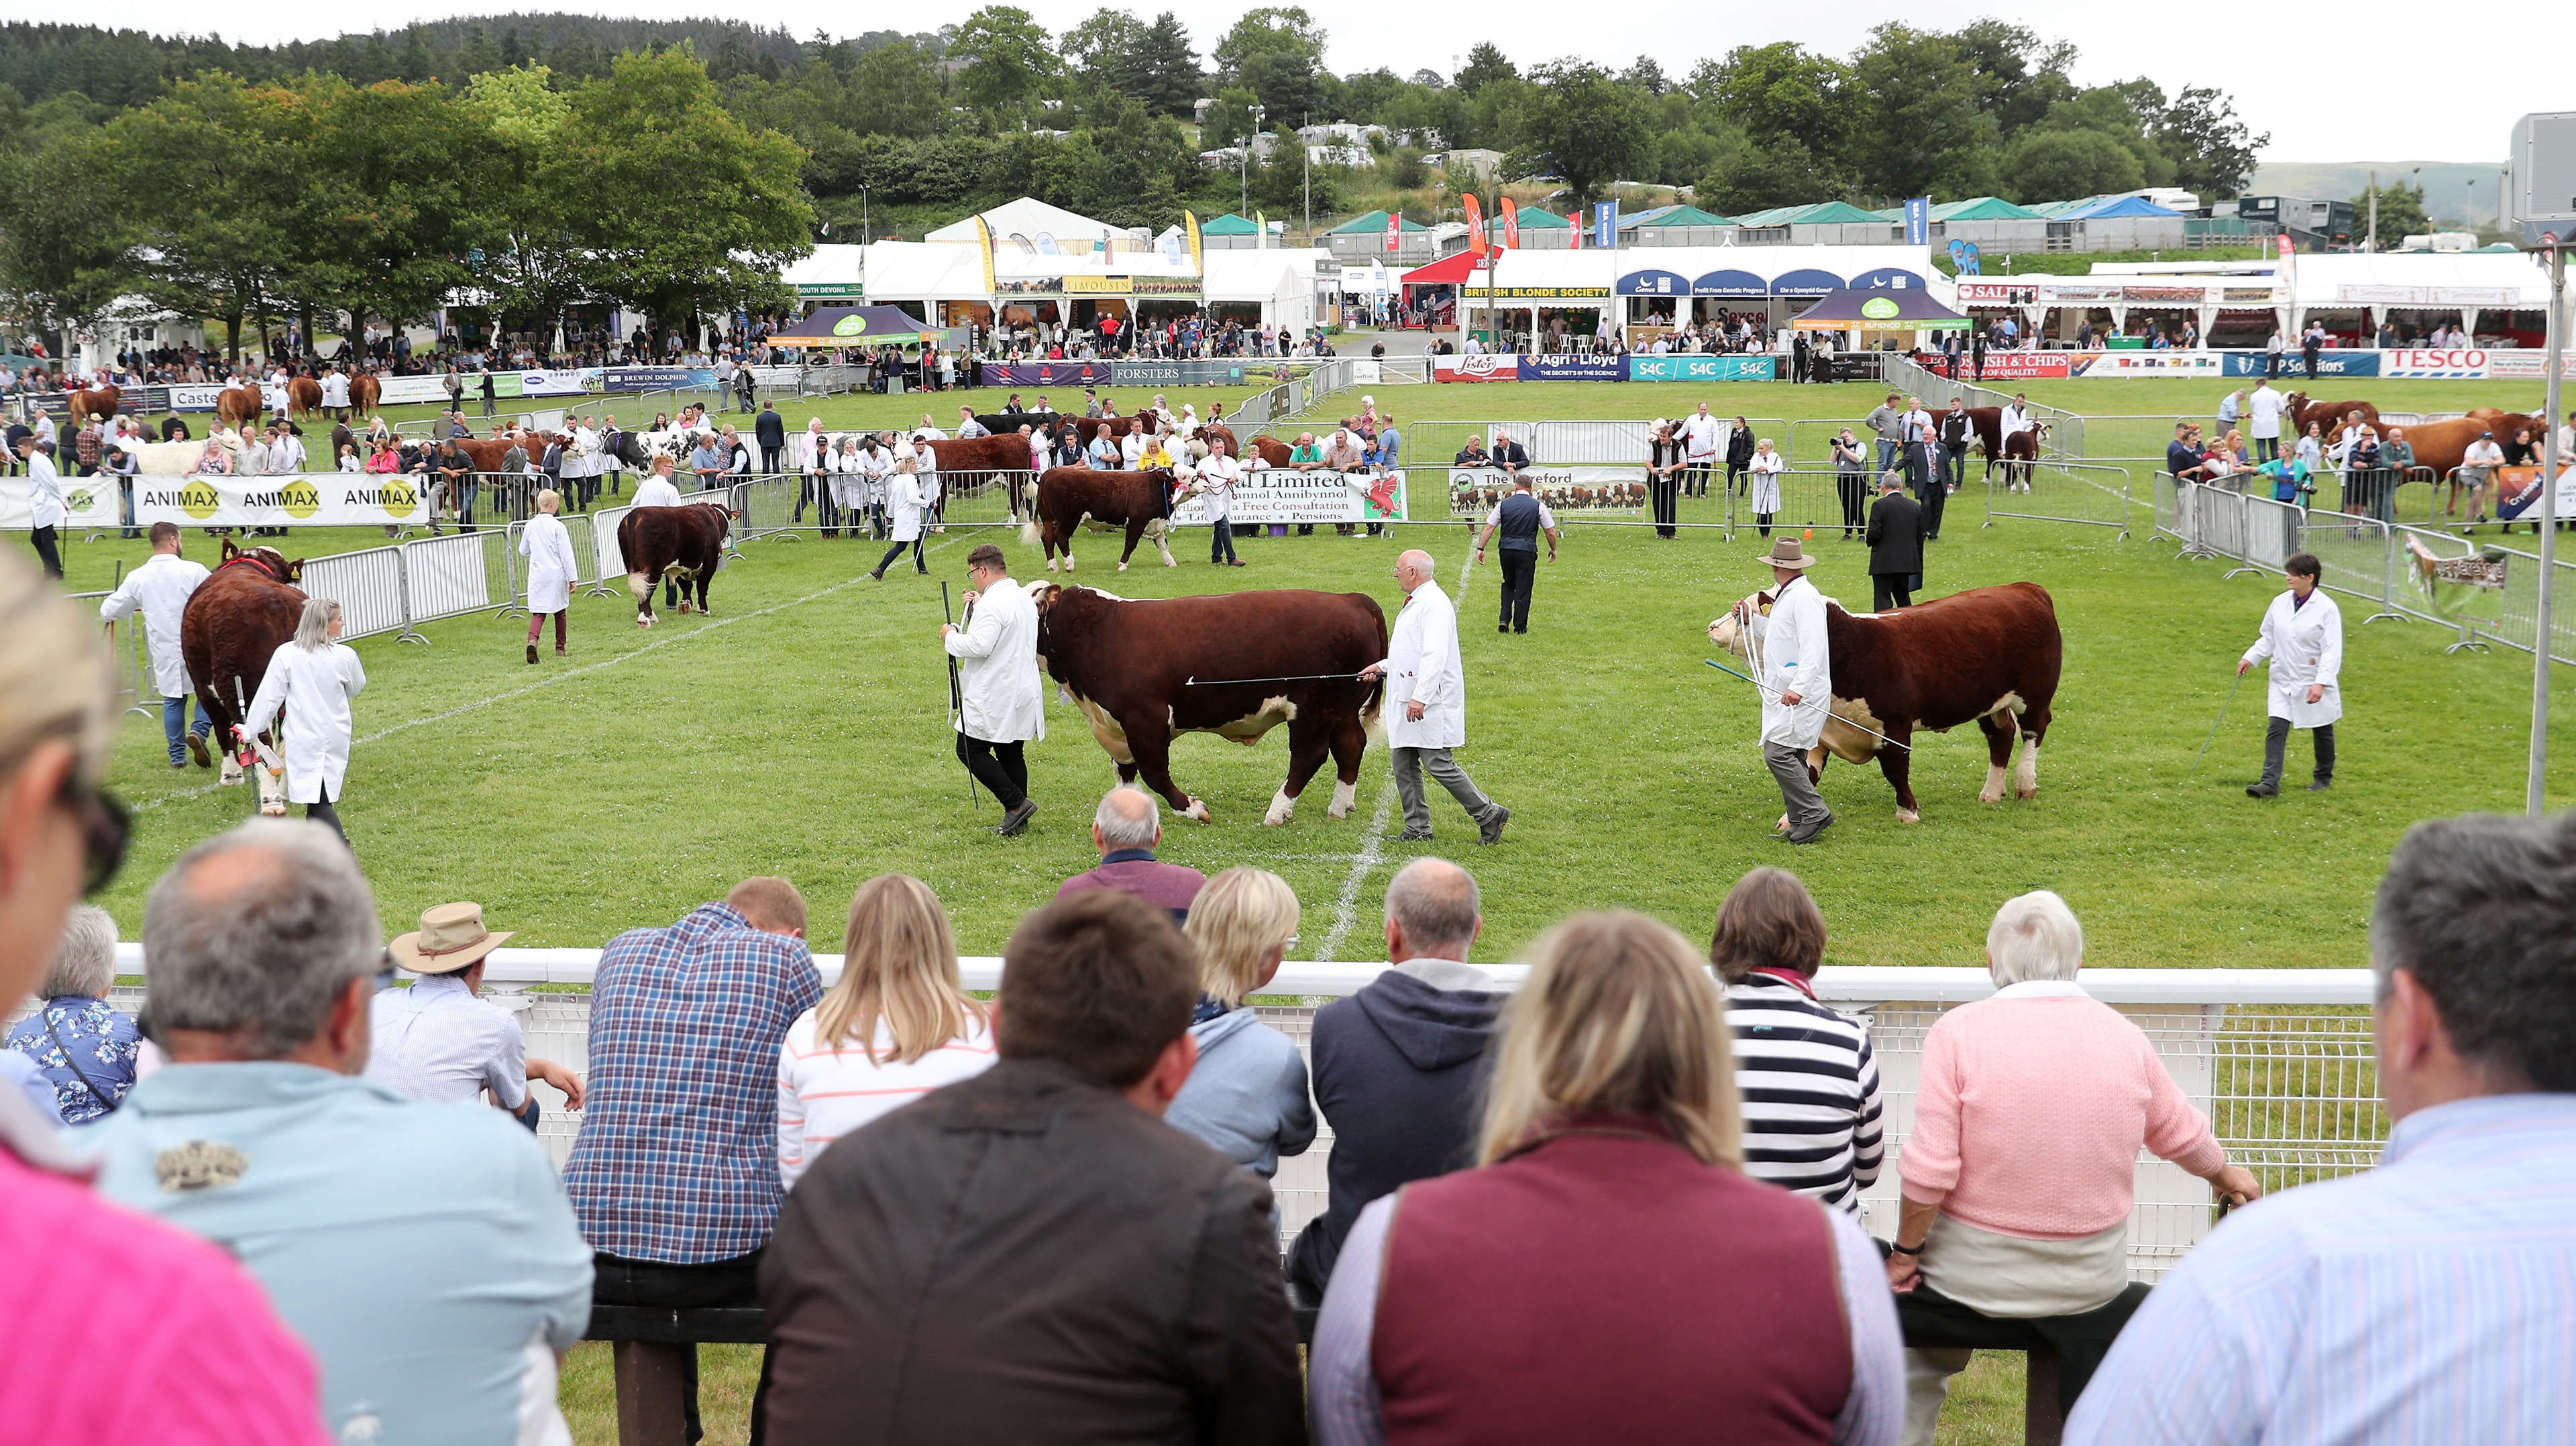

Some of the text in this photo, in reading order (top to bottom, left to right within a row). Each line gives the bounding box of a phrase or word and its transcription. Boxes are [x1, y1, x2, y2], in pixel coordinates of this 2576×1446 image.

[1068, 282, 1128, 290] LIMOUSIN
[1658, 278, 1671, 286] ABS
[1465, 289, 1607, 297] BRITSH BLONDE SOCIETY
[1455, 355, 1497, 374] Lister
[1540, 353, 1617, 367] Agri Lloyd
[2025, 355, 2067, 367] CHIPS
[2389, 349, 2486, 368] TESCO
[1117, 369, 1179, 378] FORSTERS
[1639, 362, 1666, 375] S4C
[1689, 362, 1716, 375] S4C
[1740, 362, 1767, 375] S4C
[2002, 369, 2037, 377] QUALITY
[1260, 474, 1347, 488] Limited
[1485, 474, 1508, 484] The
[68, 495, 95, 506] MAX
[144, 491, 219, 506] ANIMAX
[244, 490, 319, 506] ANIMAX
[344, 490, 417, 505] ANIMAX
[1275, 490, 1348, 501] Annibynnol
[1242, 502, 1269, 510] Free
[1273, 502, 1349, 510] Consultation
[1292, 512, 1342, 520] Pensions
